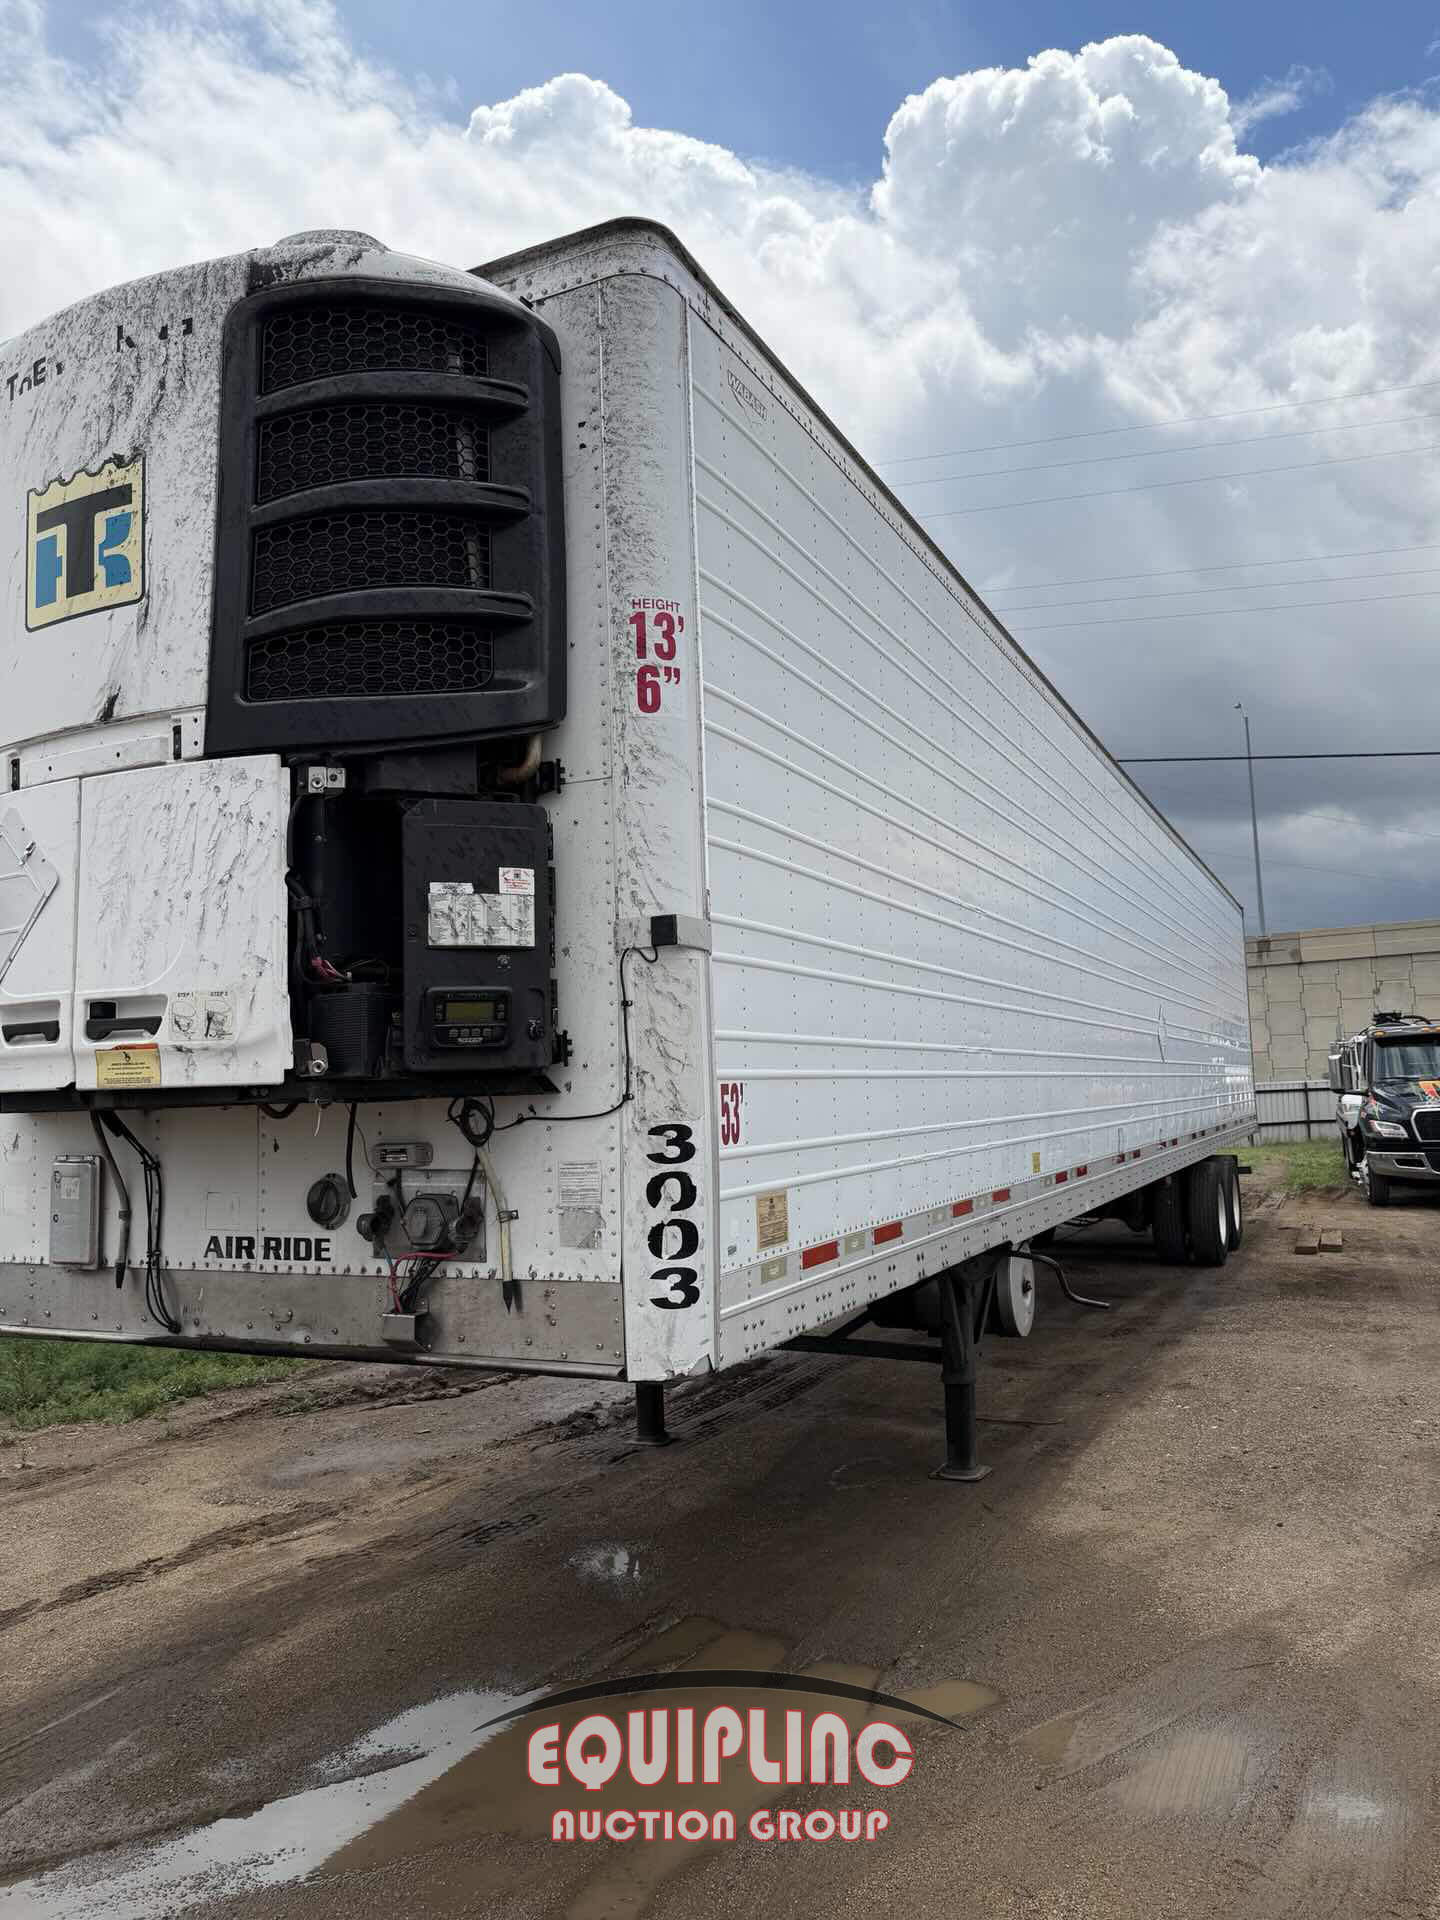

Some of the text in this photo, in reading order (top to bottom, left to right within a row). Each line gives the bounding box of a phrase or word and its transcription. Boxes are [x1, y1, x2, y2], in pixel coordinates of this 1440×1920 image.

[631, 598, 681, 613] HEIGHT
[629, 611, 685, 661] 13'
[719, 1082, 744, 1146] 53'
[203, 1235, 332, 1262] AIR RIDE
